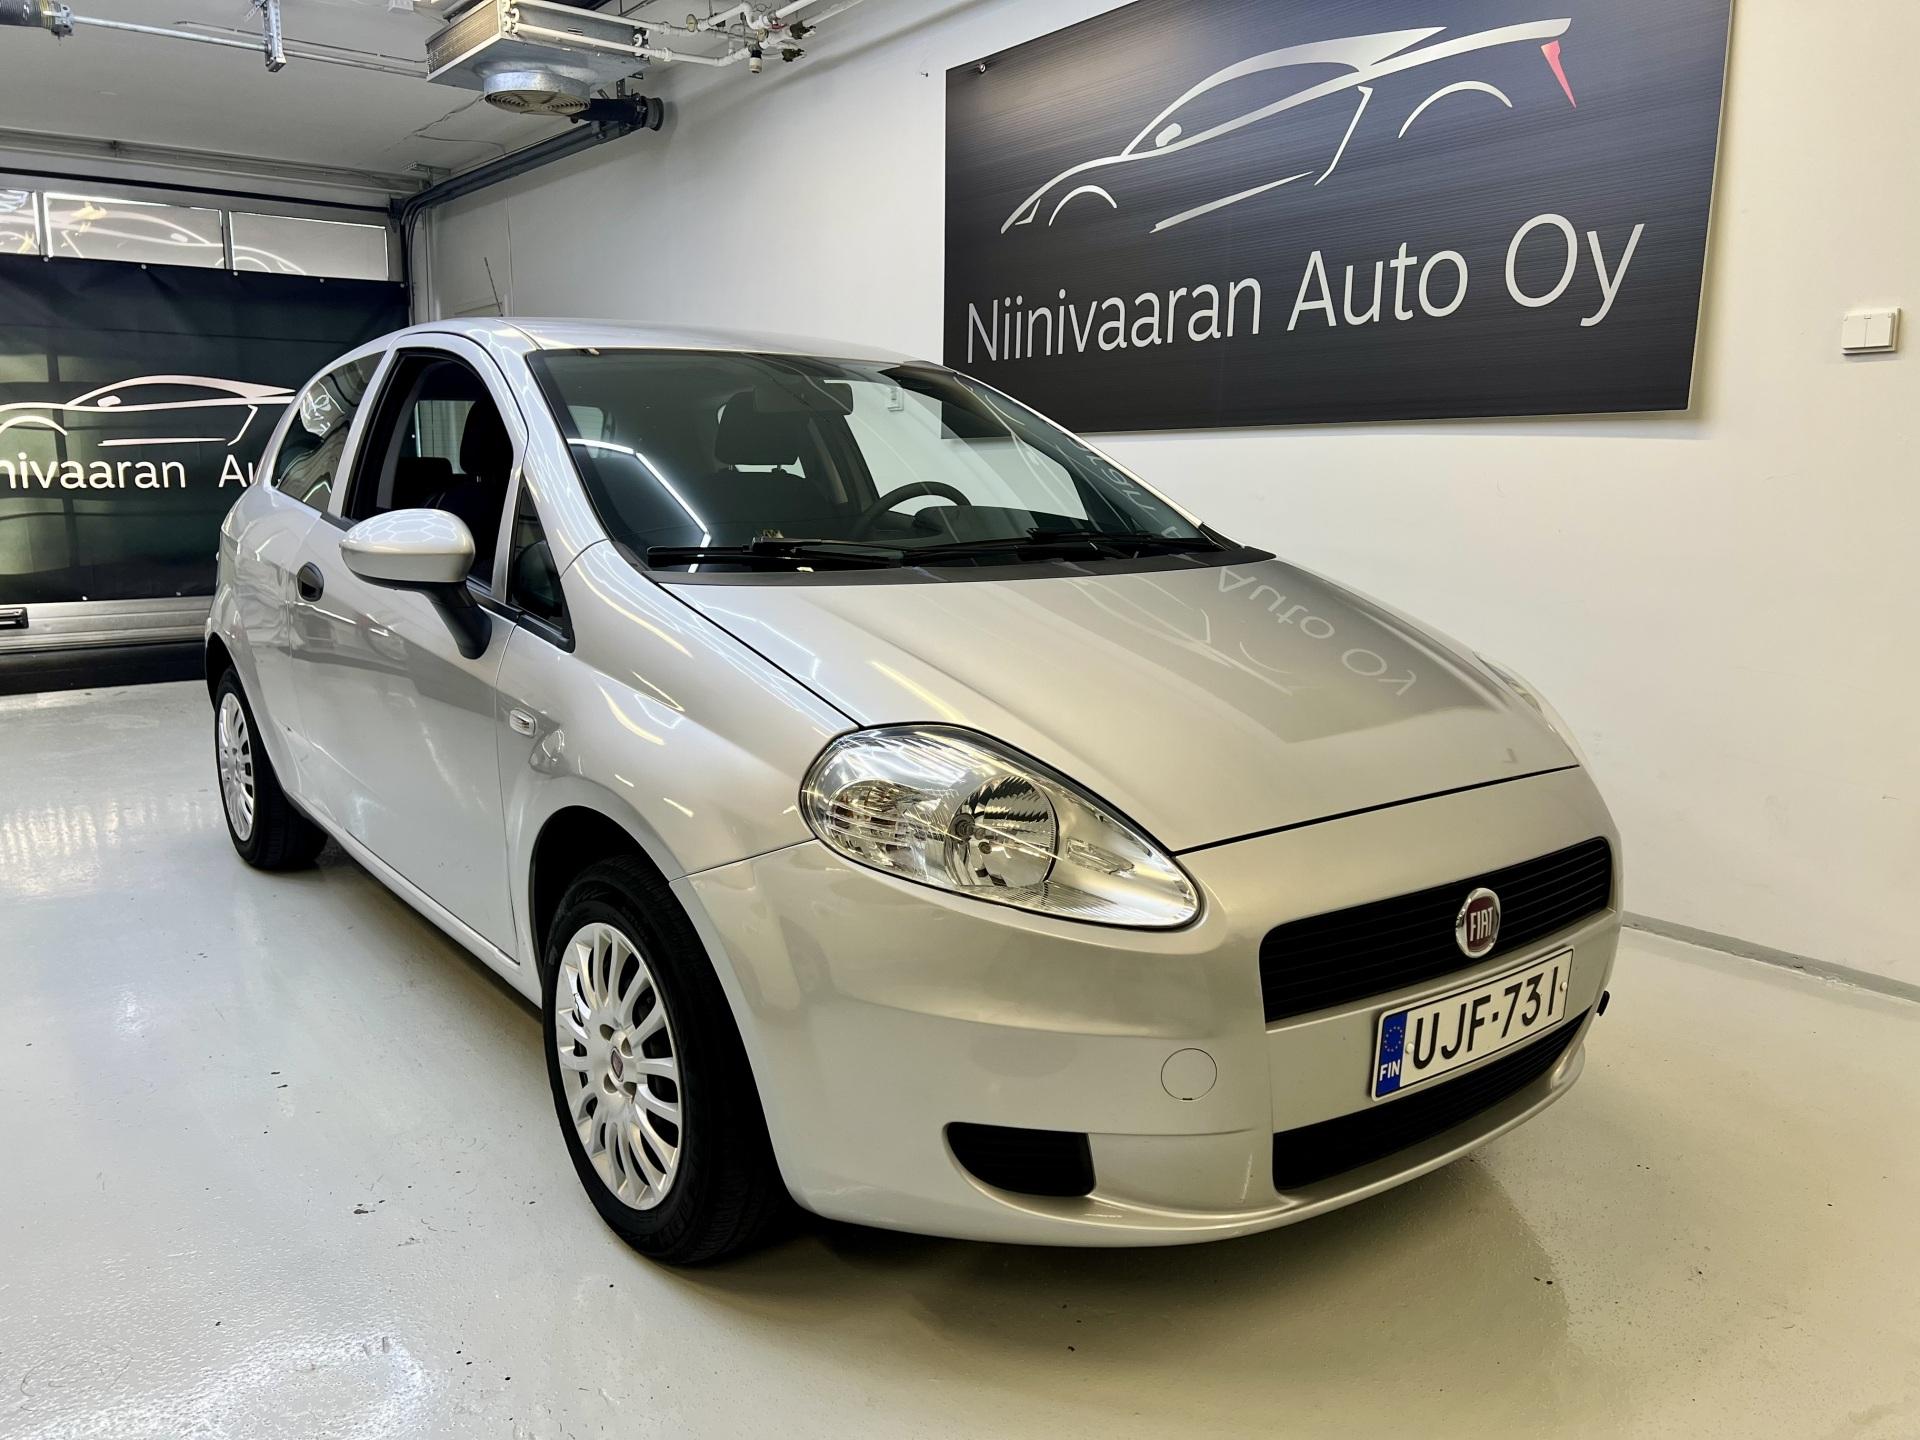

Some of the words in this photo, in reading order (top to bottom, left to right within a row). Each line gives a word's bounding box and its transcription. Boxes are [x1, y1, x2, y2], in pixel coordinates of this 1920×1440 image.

[967, 277, 1262, 364] Niinivaaran
[1287, 242, 1469, 331] Auto
[1505, 213, 1645, 327] Oy
[1469, 906, 1494, 941] FIAT
[1413, 966, 1559, 1070] UJF-731
[1379, 1059, 1401, 1081] FIN
